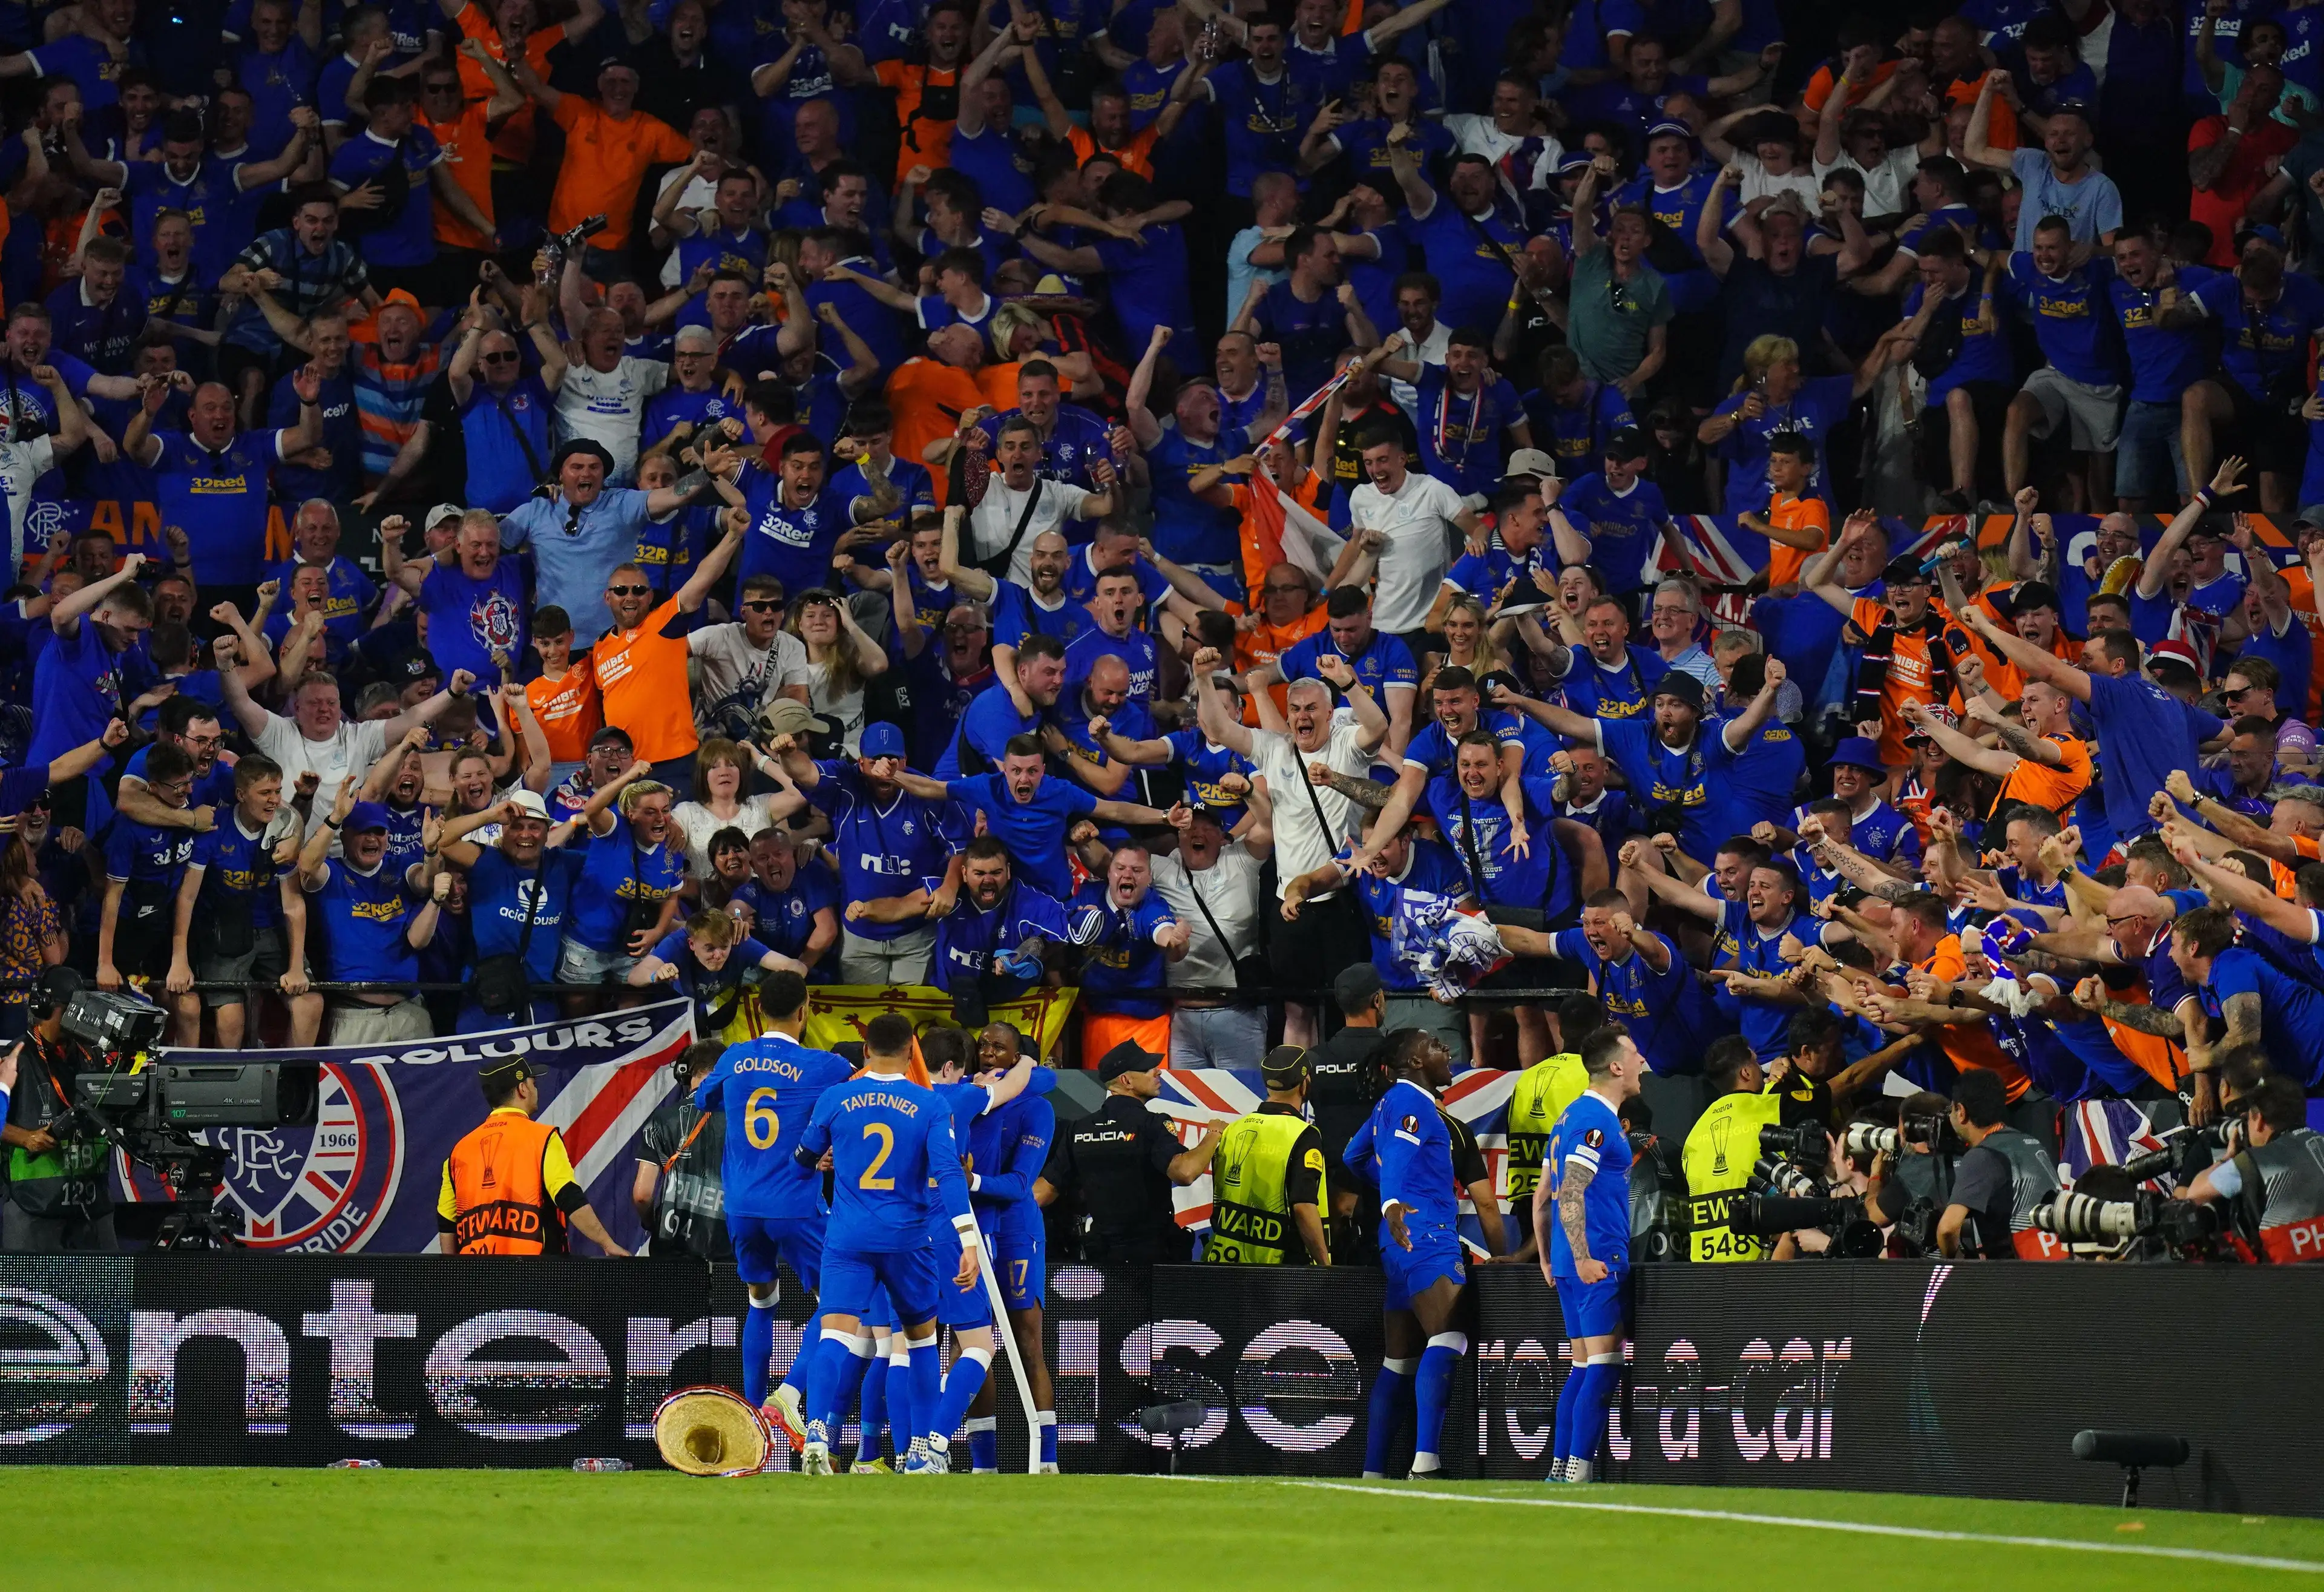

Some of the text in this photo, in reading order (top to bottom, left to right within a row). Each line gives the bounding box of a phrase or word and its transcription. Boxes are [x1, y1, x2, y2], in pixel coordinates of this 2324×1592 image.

[763, 512, 815, 542] 32Red
[597, 650, 631, 677] UNIBET
[1598, 697, 1648, 715] 32Red
[1764, 729, 1790, 740] SEKO
[499, 906, 560, 927] acidouse
[734, 1057, 803, 1083] GOLDSON
[1316, 1063, 1357, 1074] POLIC
[171, 1109, 186, 1119] 107
[744, 1087, 780, 1150] 6
[841, 1093, 919, 1119] TAVERNIER
[1712, 1102, 1733, 1114] 2021/24
[320, 1134, 358, 1148] 1966
[1074, 1131, 1126, 1143] POLICIA
[859, 1122, 895, 1191] 2
[457, 1209, 537, 1245] STEWARD
[1701, 1232, 1751, 1261] 548
[1009, 1259, 1029, 1287] 17
[0, 1268, 1362, 1472] enterise
